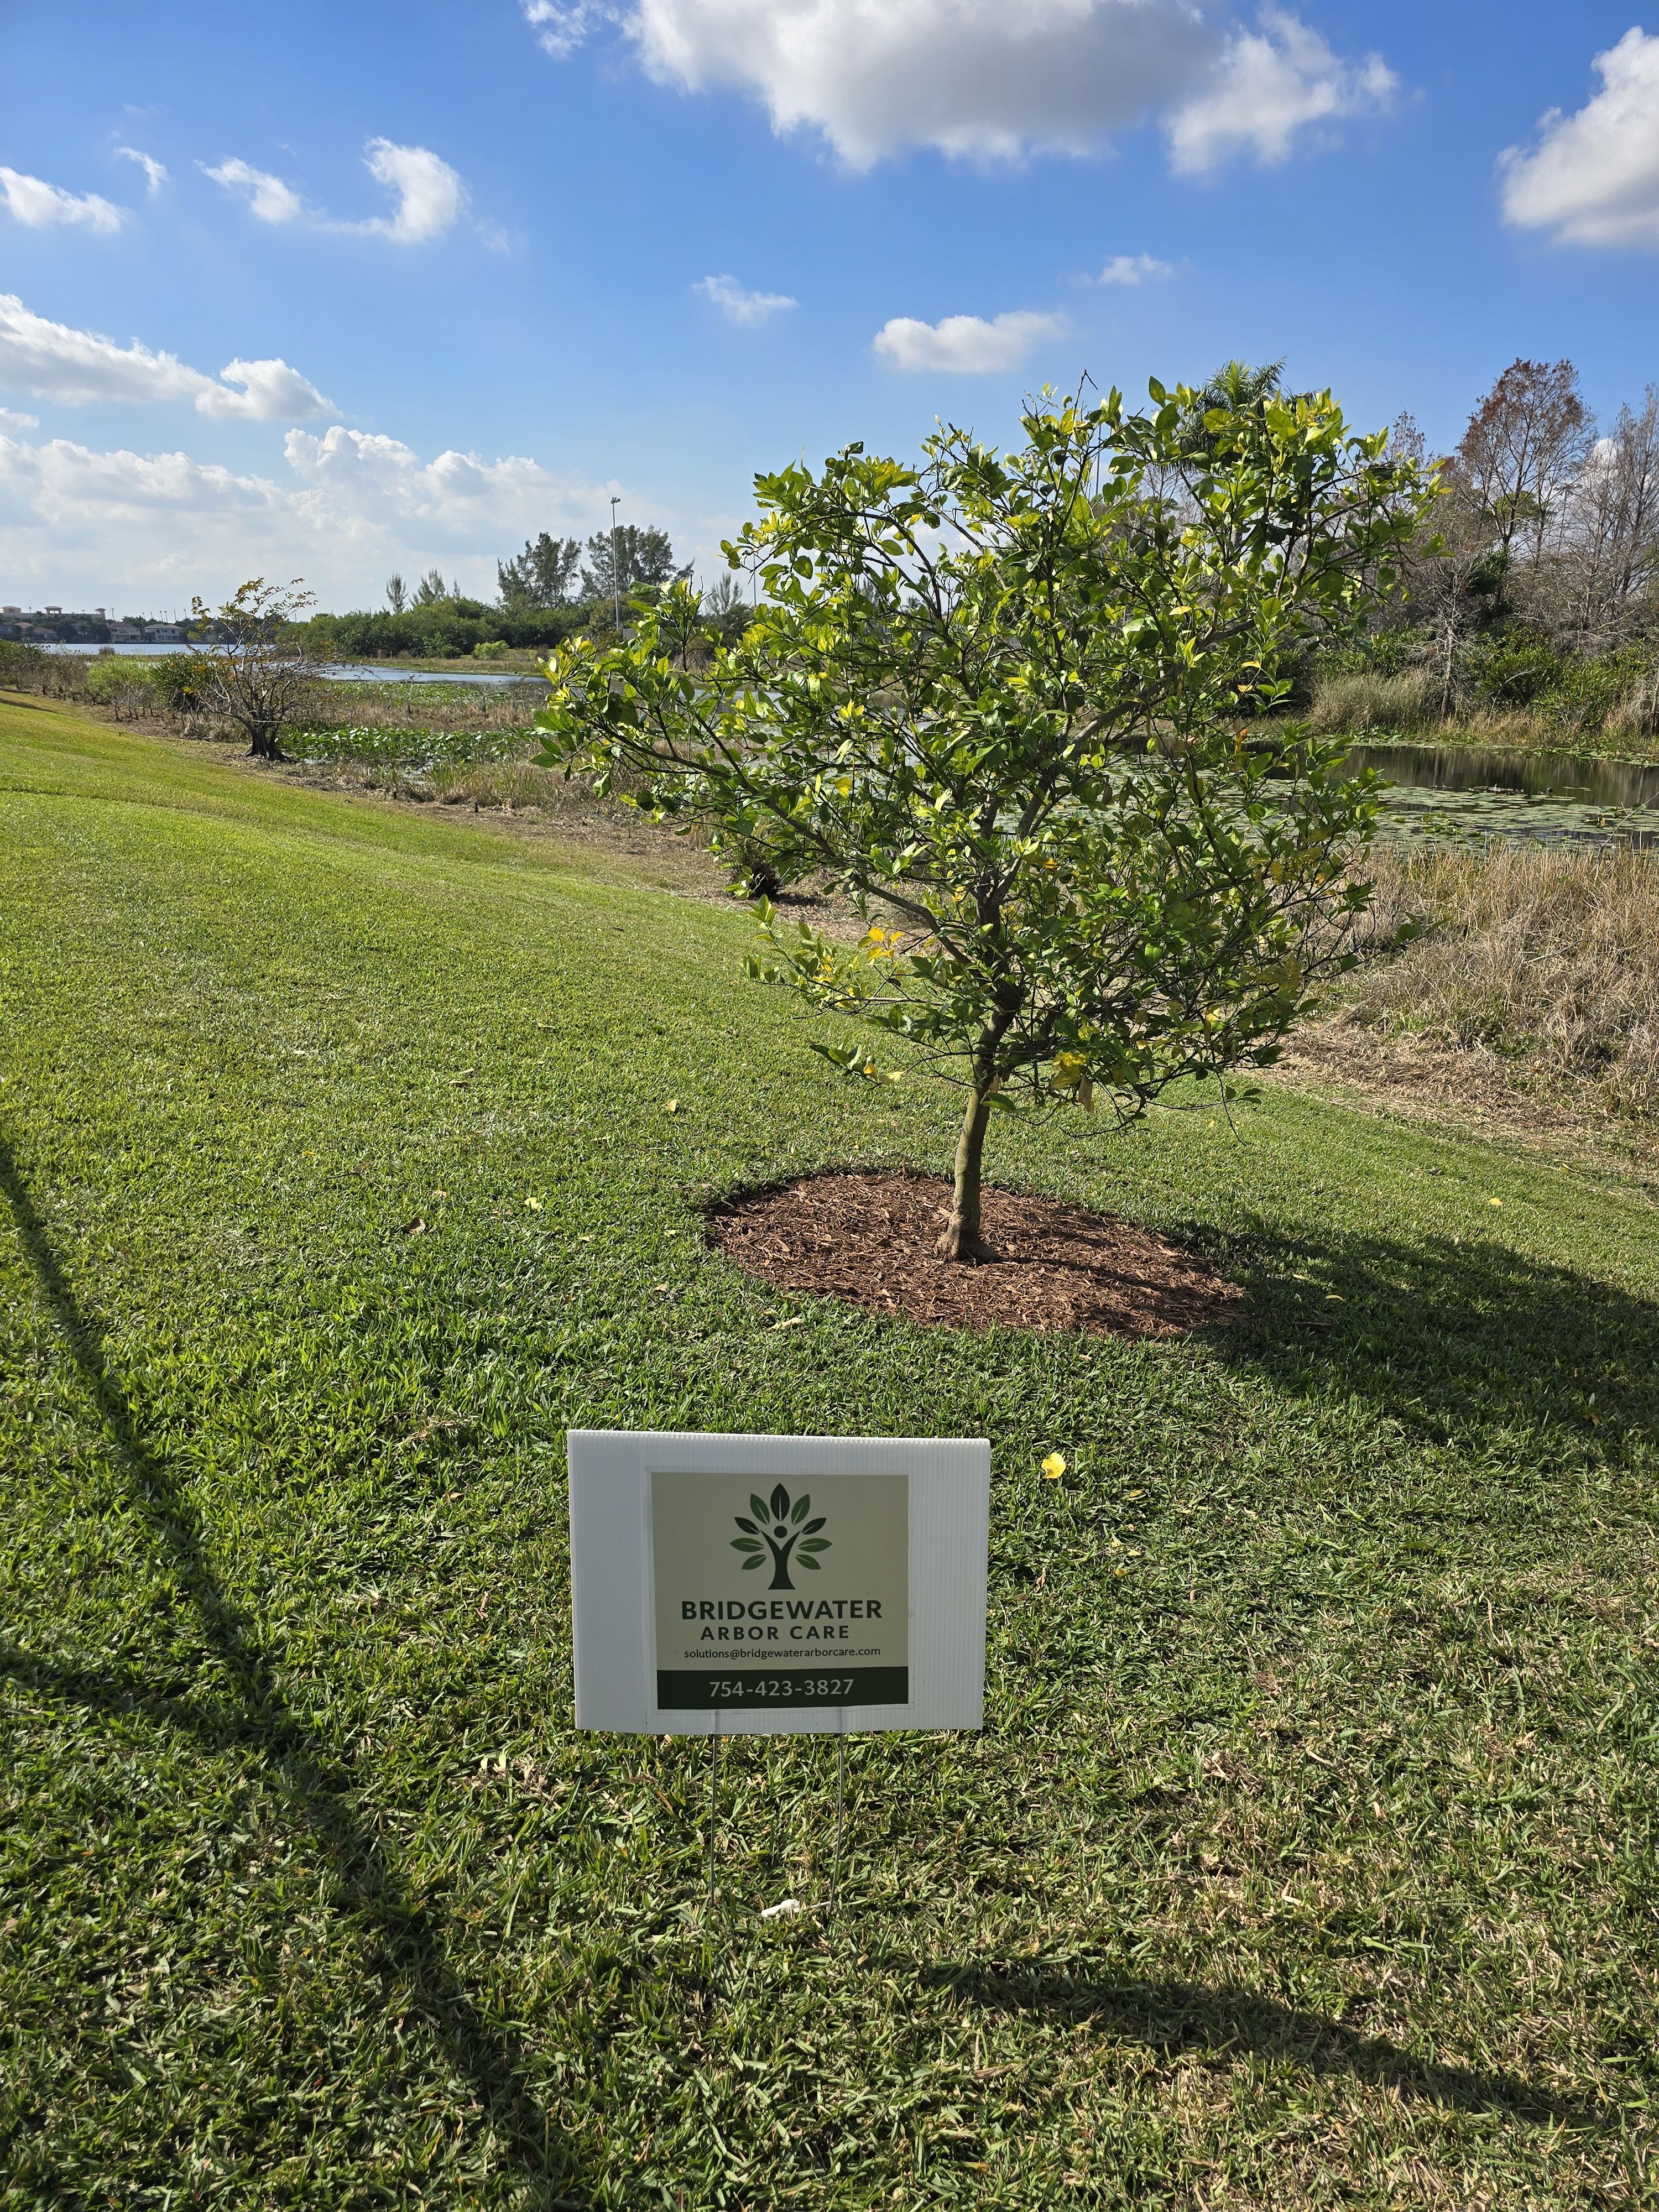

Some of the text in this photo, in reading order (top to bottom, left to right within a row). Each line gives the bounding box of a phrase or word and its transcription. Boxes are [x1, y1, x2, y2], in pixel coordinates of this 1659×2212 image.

[681, 1600, 883, 1620] BRIDGEWATER
[700, 1625, 849, 1640] ARBOR CARE
[684, 1647, 880, 1660] solutions@bridgewaterarborcare.com
[709, 1679, 854, 1697] 754-423-3827
